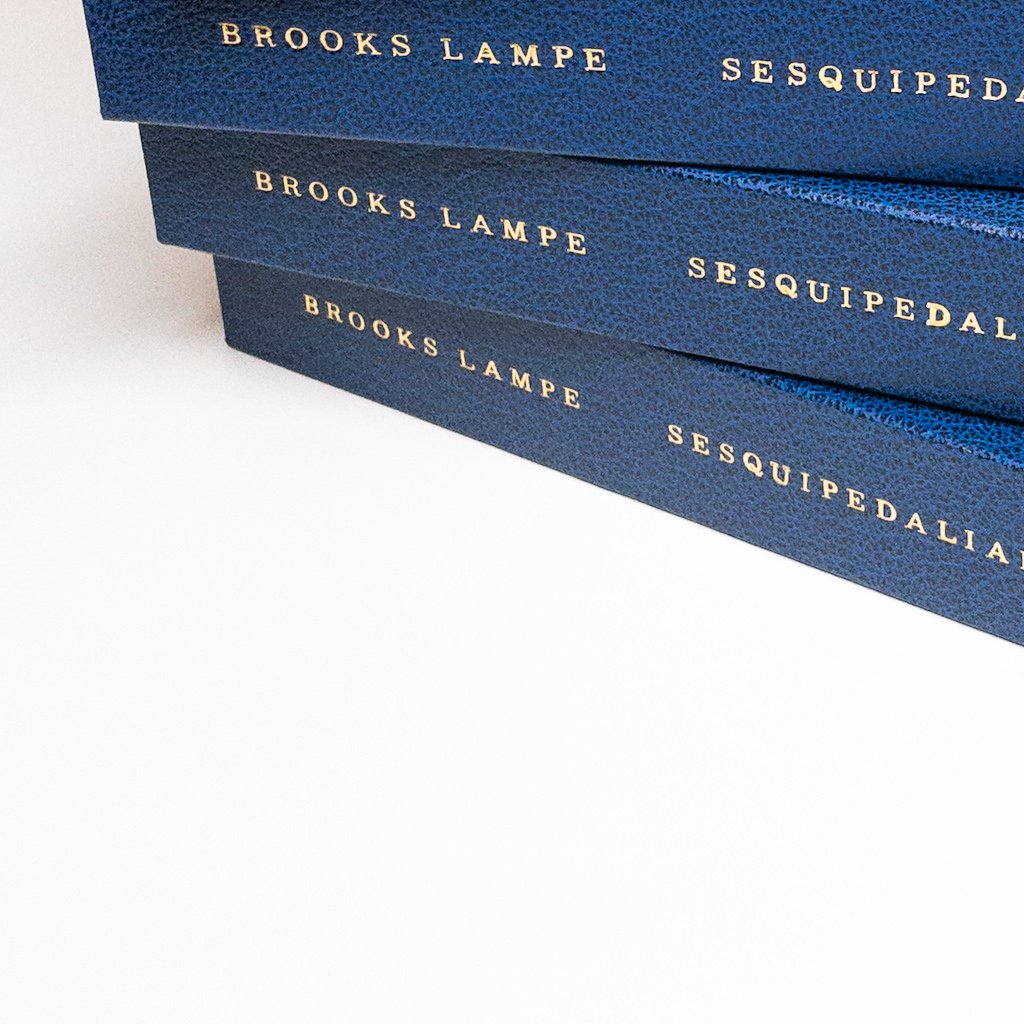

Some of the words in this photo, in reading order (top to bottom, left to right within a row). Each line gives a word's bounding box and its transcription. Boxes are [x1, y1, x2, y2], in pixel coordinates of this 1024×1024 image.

[221, 22, 410, 56] BROOKS
[441, 38, 606, 71] LAMPE
[254, 170, 415, 218] BROOKS
[440, 207, 586, 254] LAMPE
[303, 294, 438, 356] BROOKS
[459, 349, 580, 409] LAMPE
